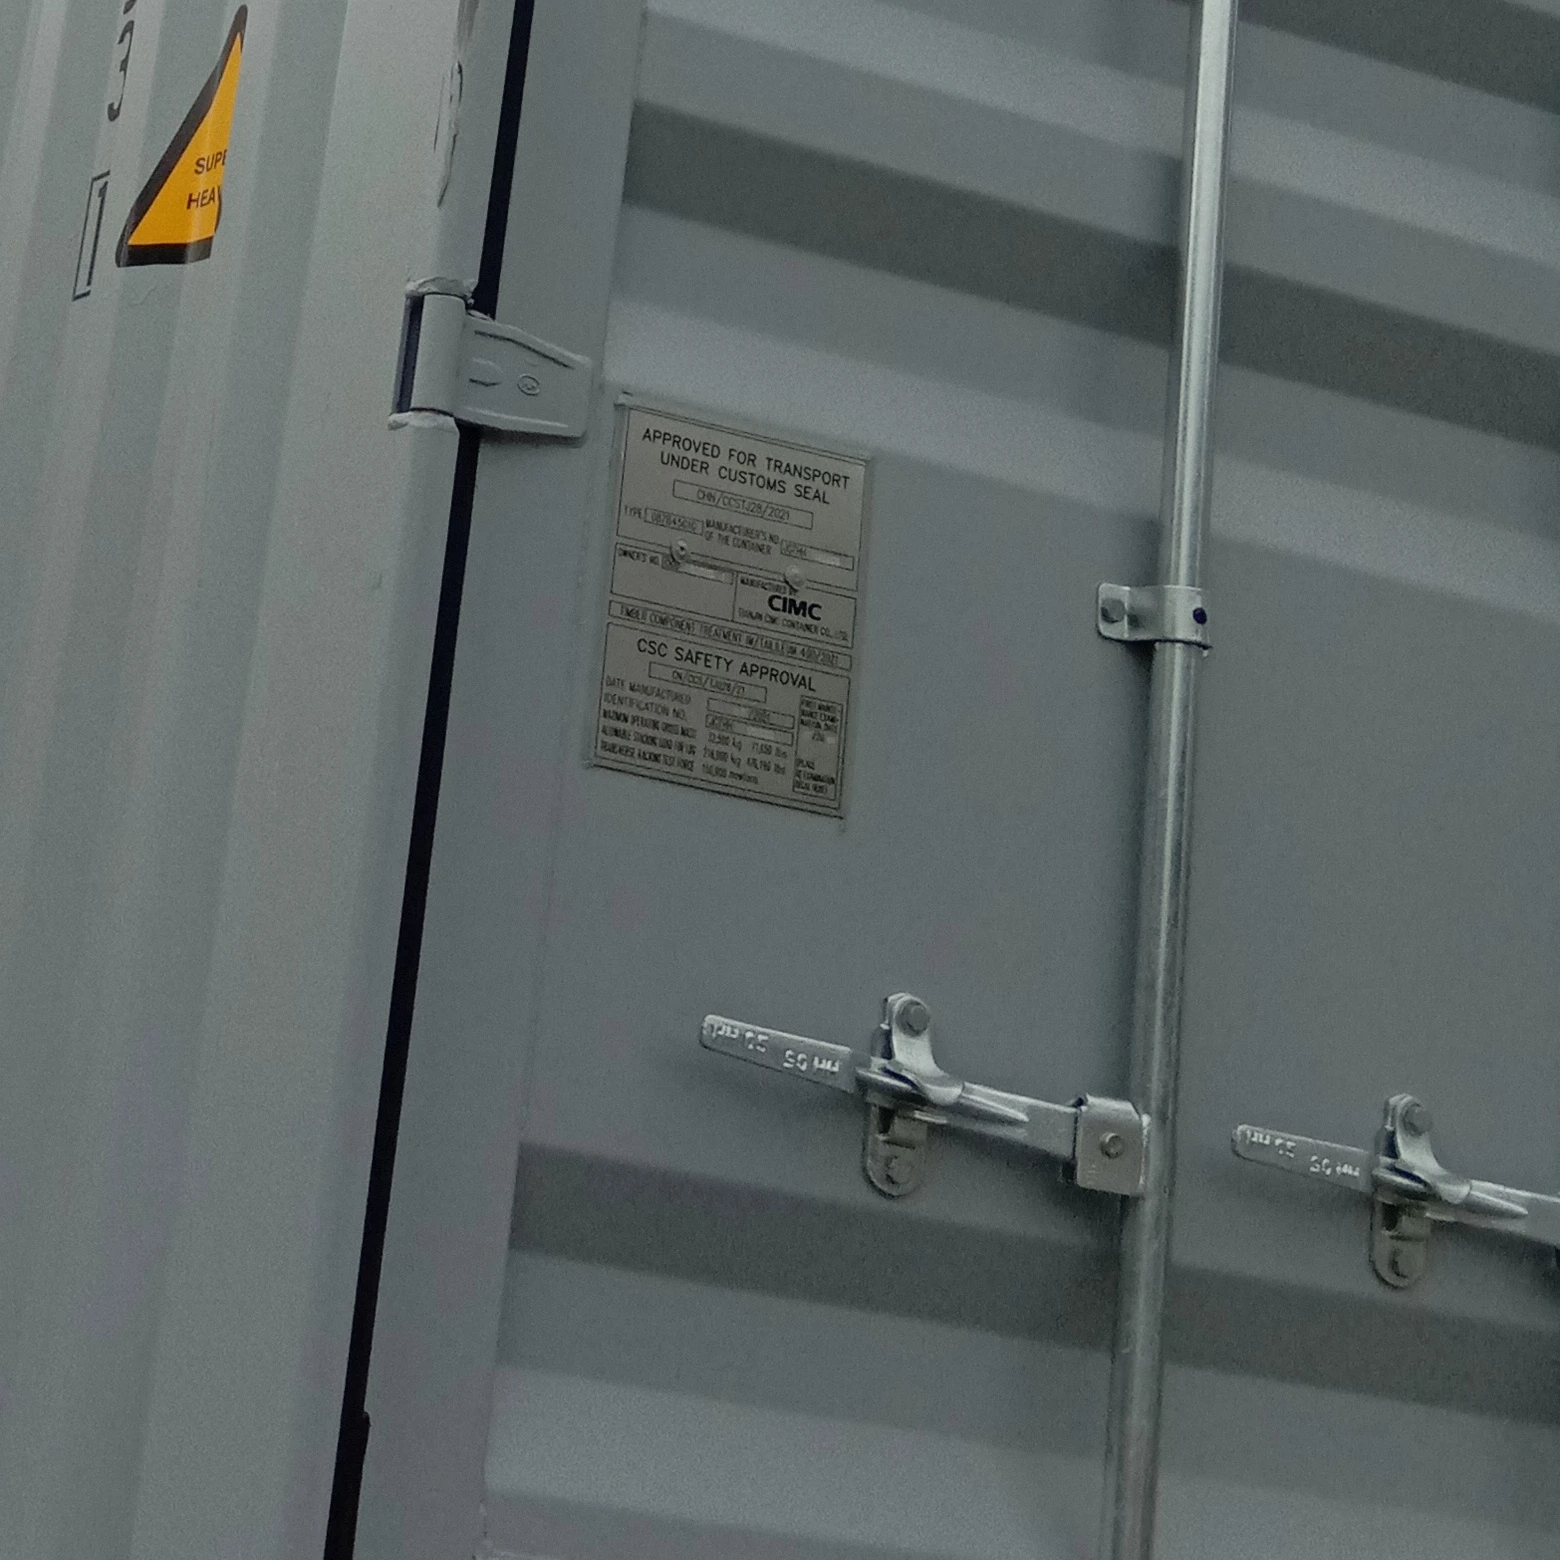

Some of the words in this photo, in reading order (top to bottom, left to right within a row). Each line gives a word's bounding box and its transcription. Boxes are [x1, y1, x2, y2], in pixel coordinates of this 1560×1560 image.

[641, 426, 721, 459] APPROVED
[727, 446, 757, 468] FOR
[764, 455, 850, 490] TRANSPORT
[659, 450, 710, 476] UNDER
[717, 464, 787, 494] CUSTOMS
[793, 482, 830, 505] SEAL
[766, 592, 822, 622] CIMC
[636, 636, 668, 658] CSC
[673, 644, 733, 673] SAFETY
[738, 659, 817, 692] APPROVAL
